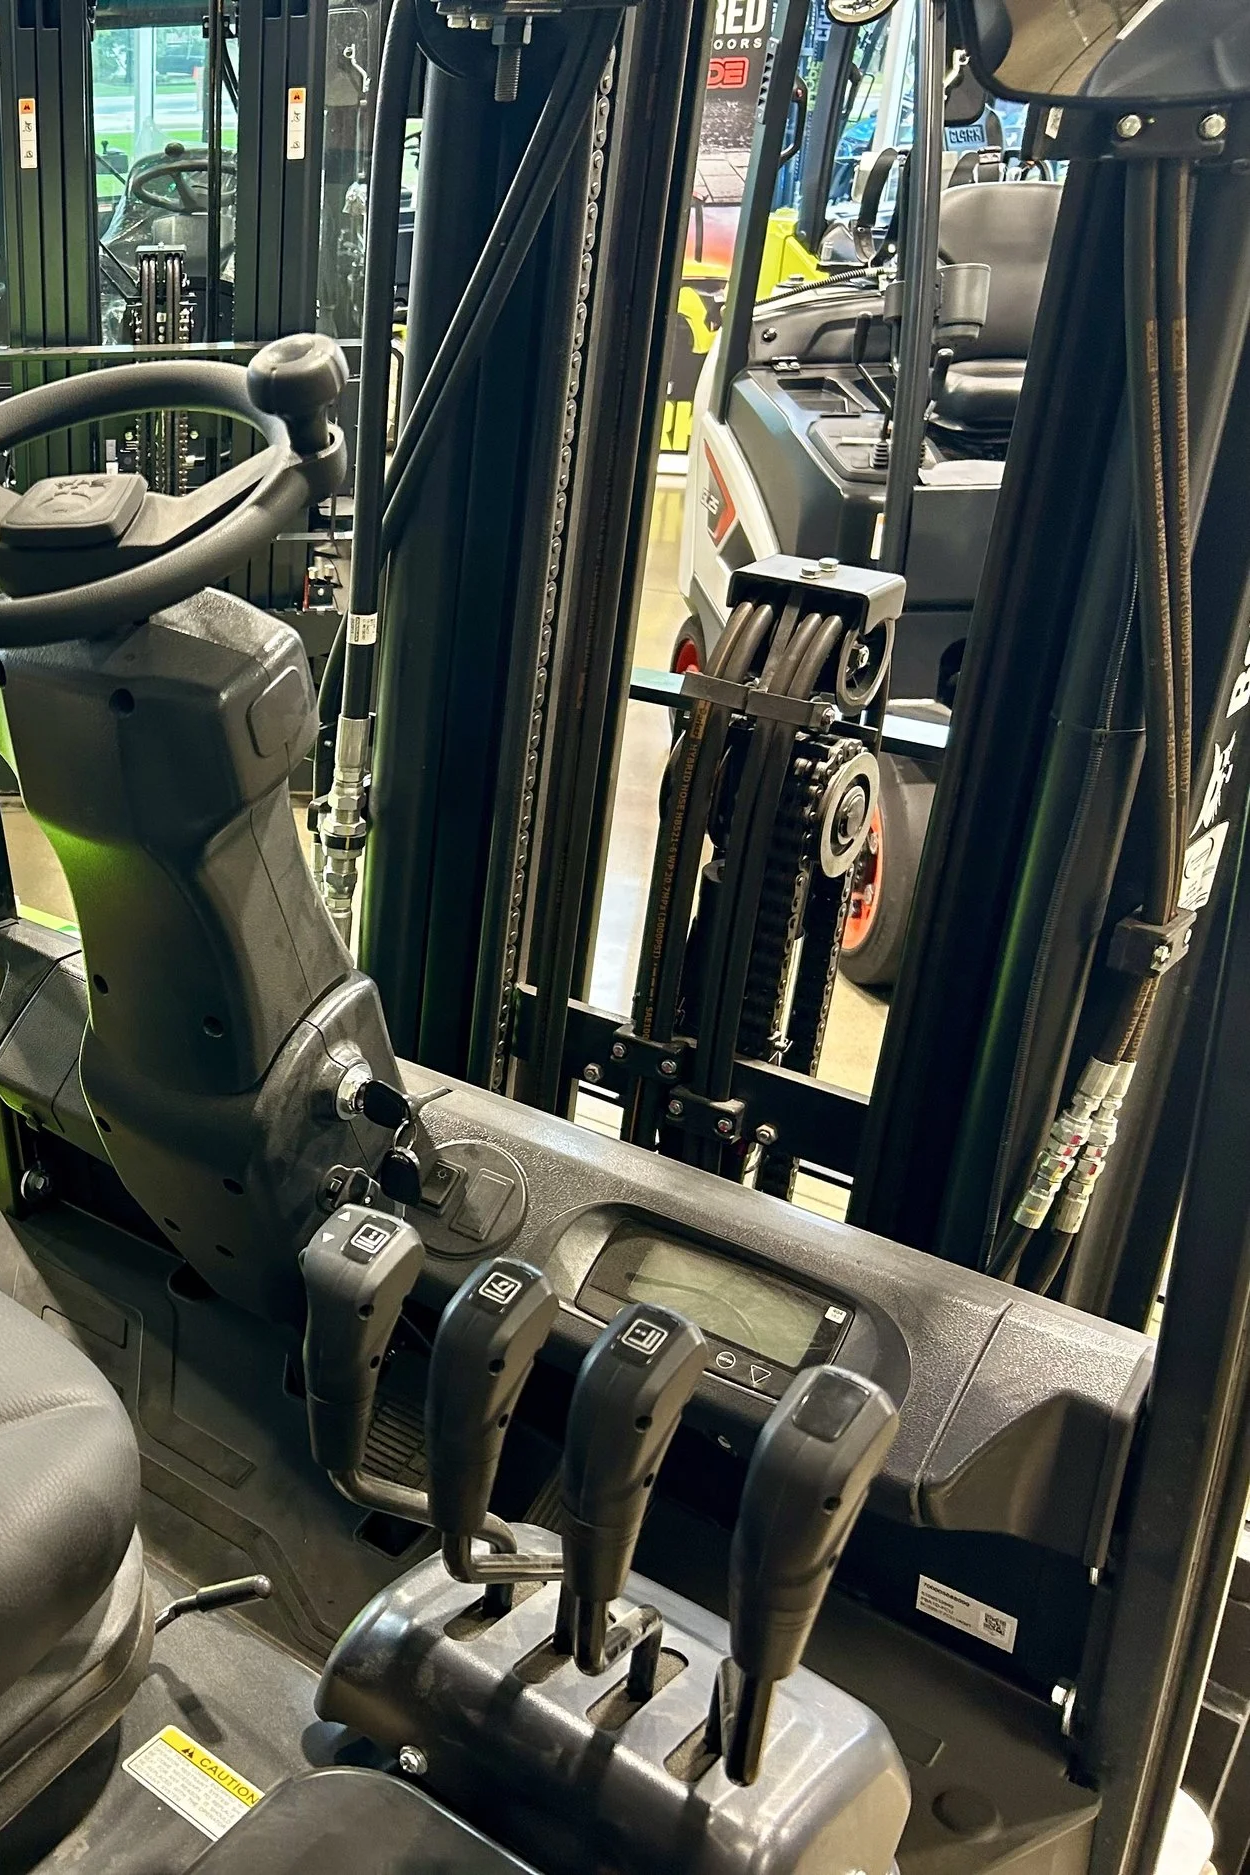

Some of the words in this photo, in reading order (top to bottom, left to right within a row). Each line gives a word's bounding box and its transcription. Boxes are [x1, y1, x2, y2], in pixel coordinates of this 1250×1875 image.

[682, 744, 698, 782] HYBRID
[676, 784, 689, 811] HOSE
[667, 855, 677, 870] WP
[659, 871, 674, 910] 20.7MPa
[652, 913, 666, 958] (3000PSI)
[199, 1757, 259, 1804] CAUTION
